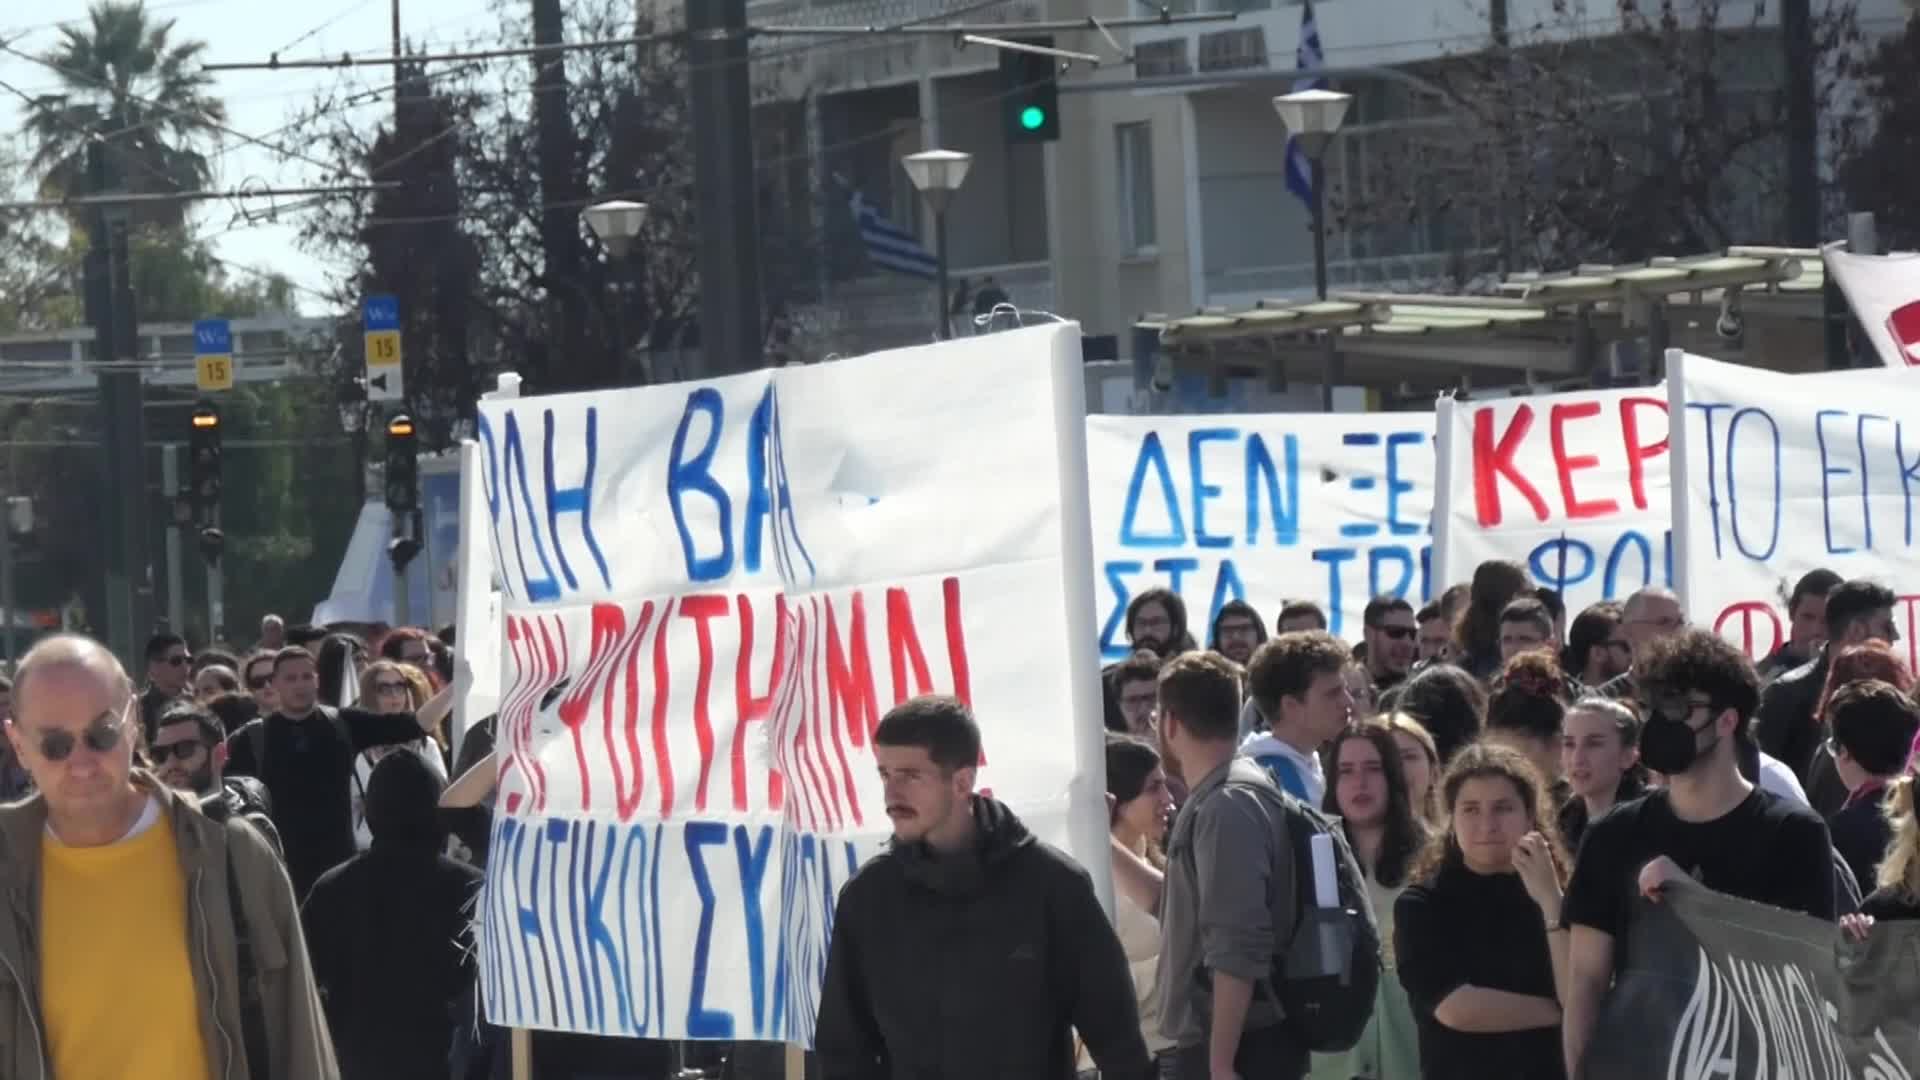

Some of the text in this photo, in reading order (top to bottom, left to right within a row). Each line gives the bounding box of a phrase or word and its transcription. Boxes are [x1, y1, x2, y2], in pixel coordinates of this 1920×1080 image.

[207, 362, 225, 381] 15
[375, 338, 393, 358] 15
[1120, 429, 1435, 547] ΔΕΝ ΞΕ
[1473, 397, 1670, 528] ΚΕΡ
[1687, 402, 1920, 561] ΤΟ ΕΓΚ
